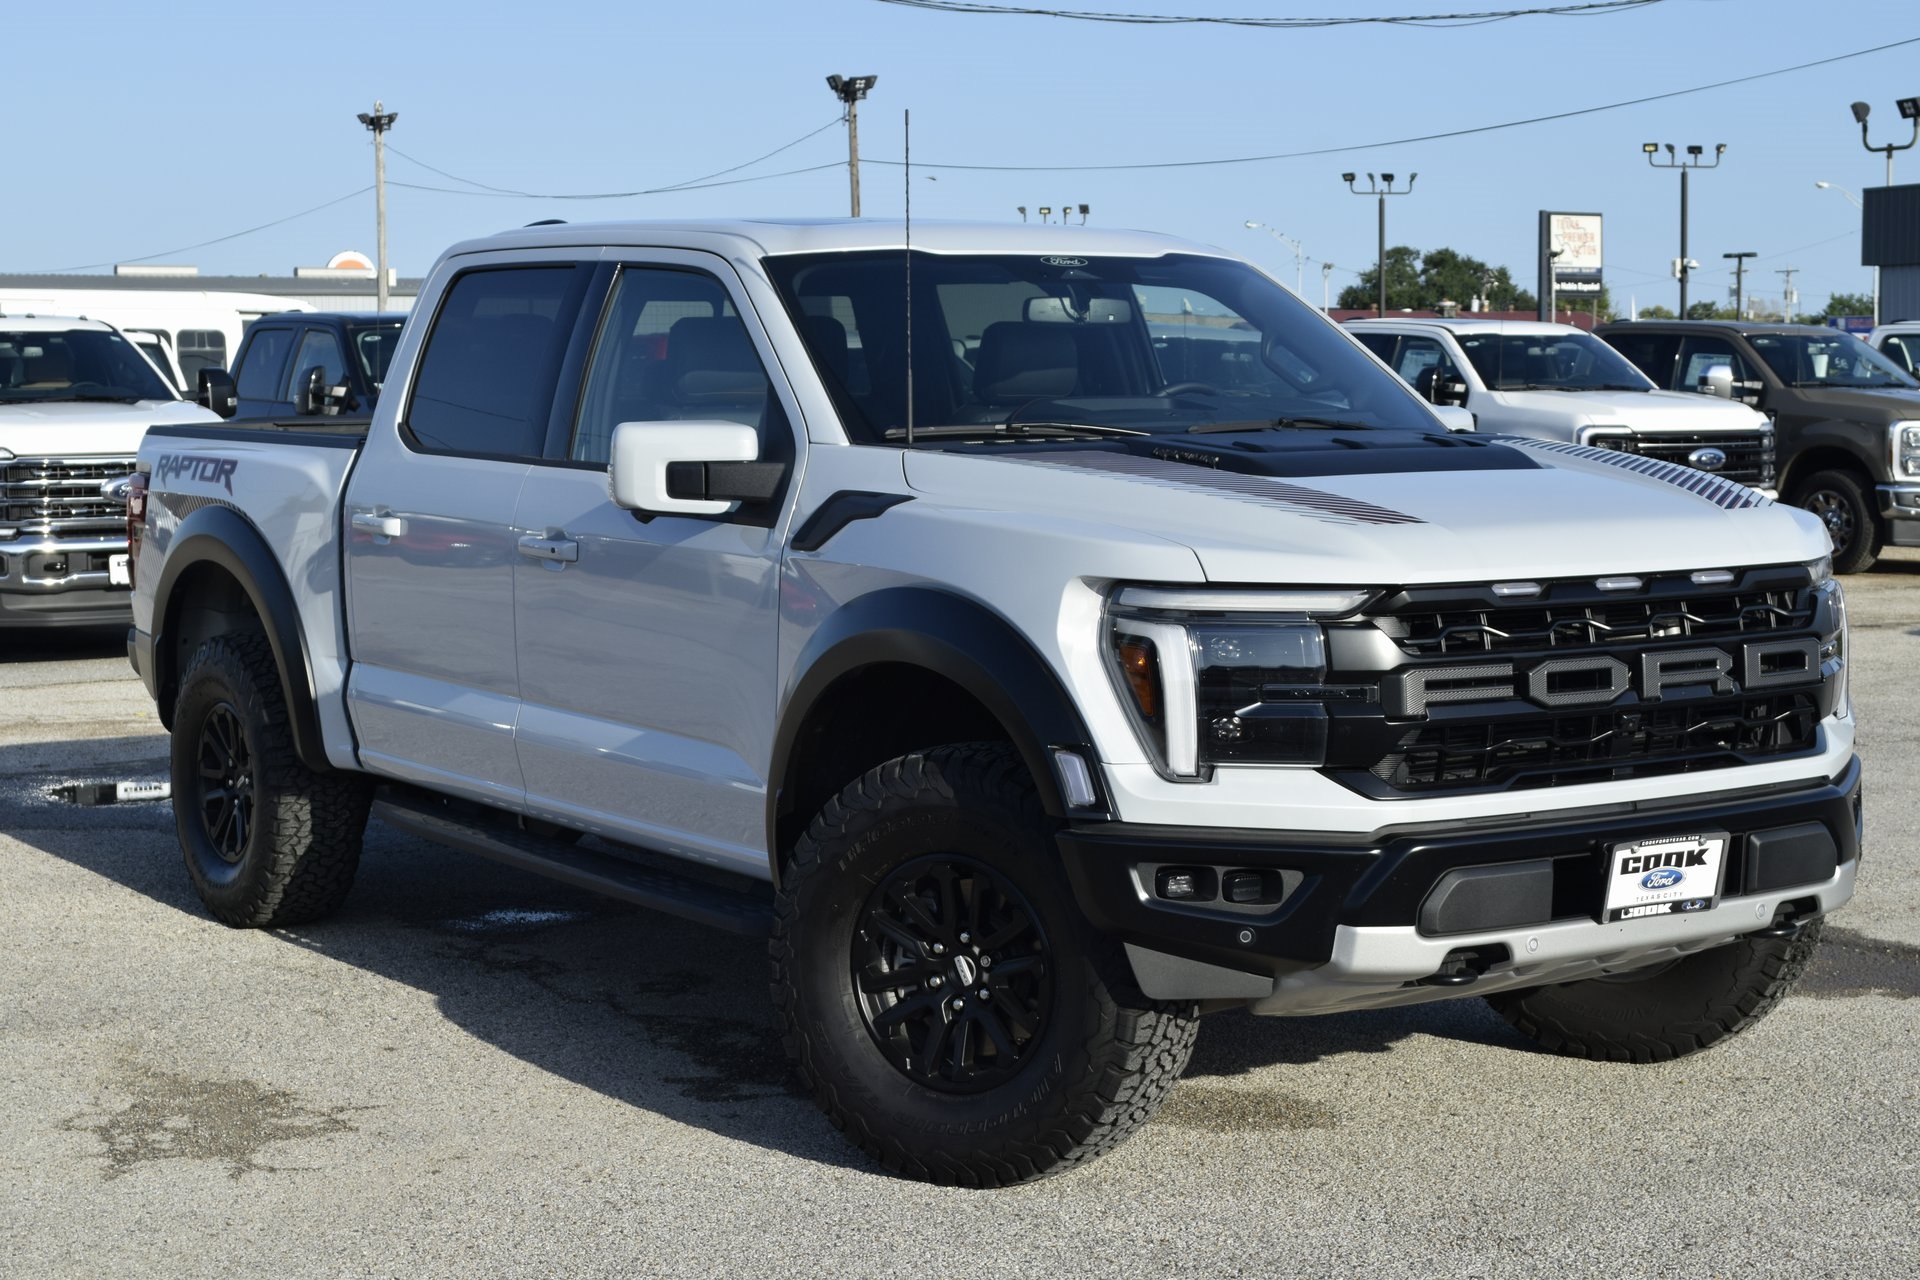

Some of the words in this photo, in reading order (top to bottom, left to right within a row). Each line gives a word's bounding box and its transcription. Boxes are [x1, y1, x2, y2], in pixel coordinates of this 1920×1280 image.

[1050, 256, 1081, 265] Ford
[155, 454, 238, 496] RAPTOR
[1403, 636, 1821, 716] FORD
[1620, 847, 1710, 875] COOK
[1647, 871, 1675, 888] Ford
[1636, 893, 1663, 902] TEXAS
[1663, 892, 1684, 900] CITY
[1621, 903, 1672, 918] COOK
